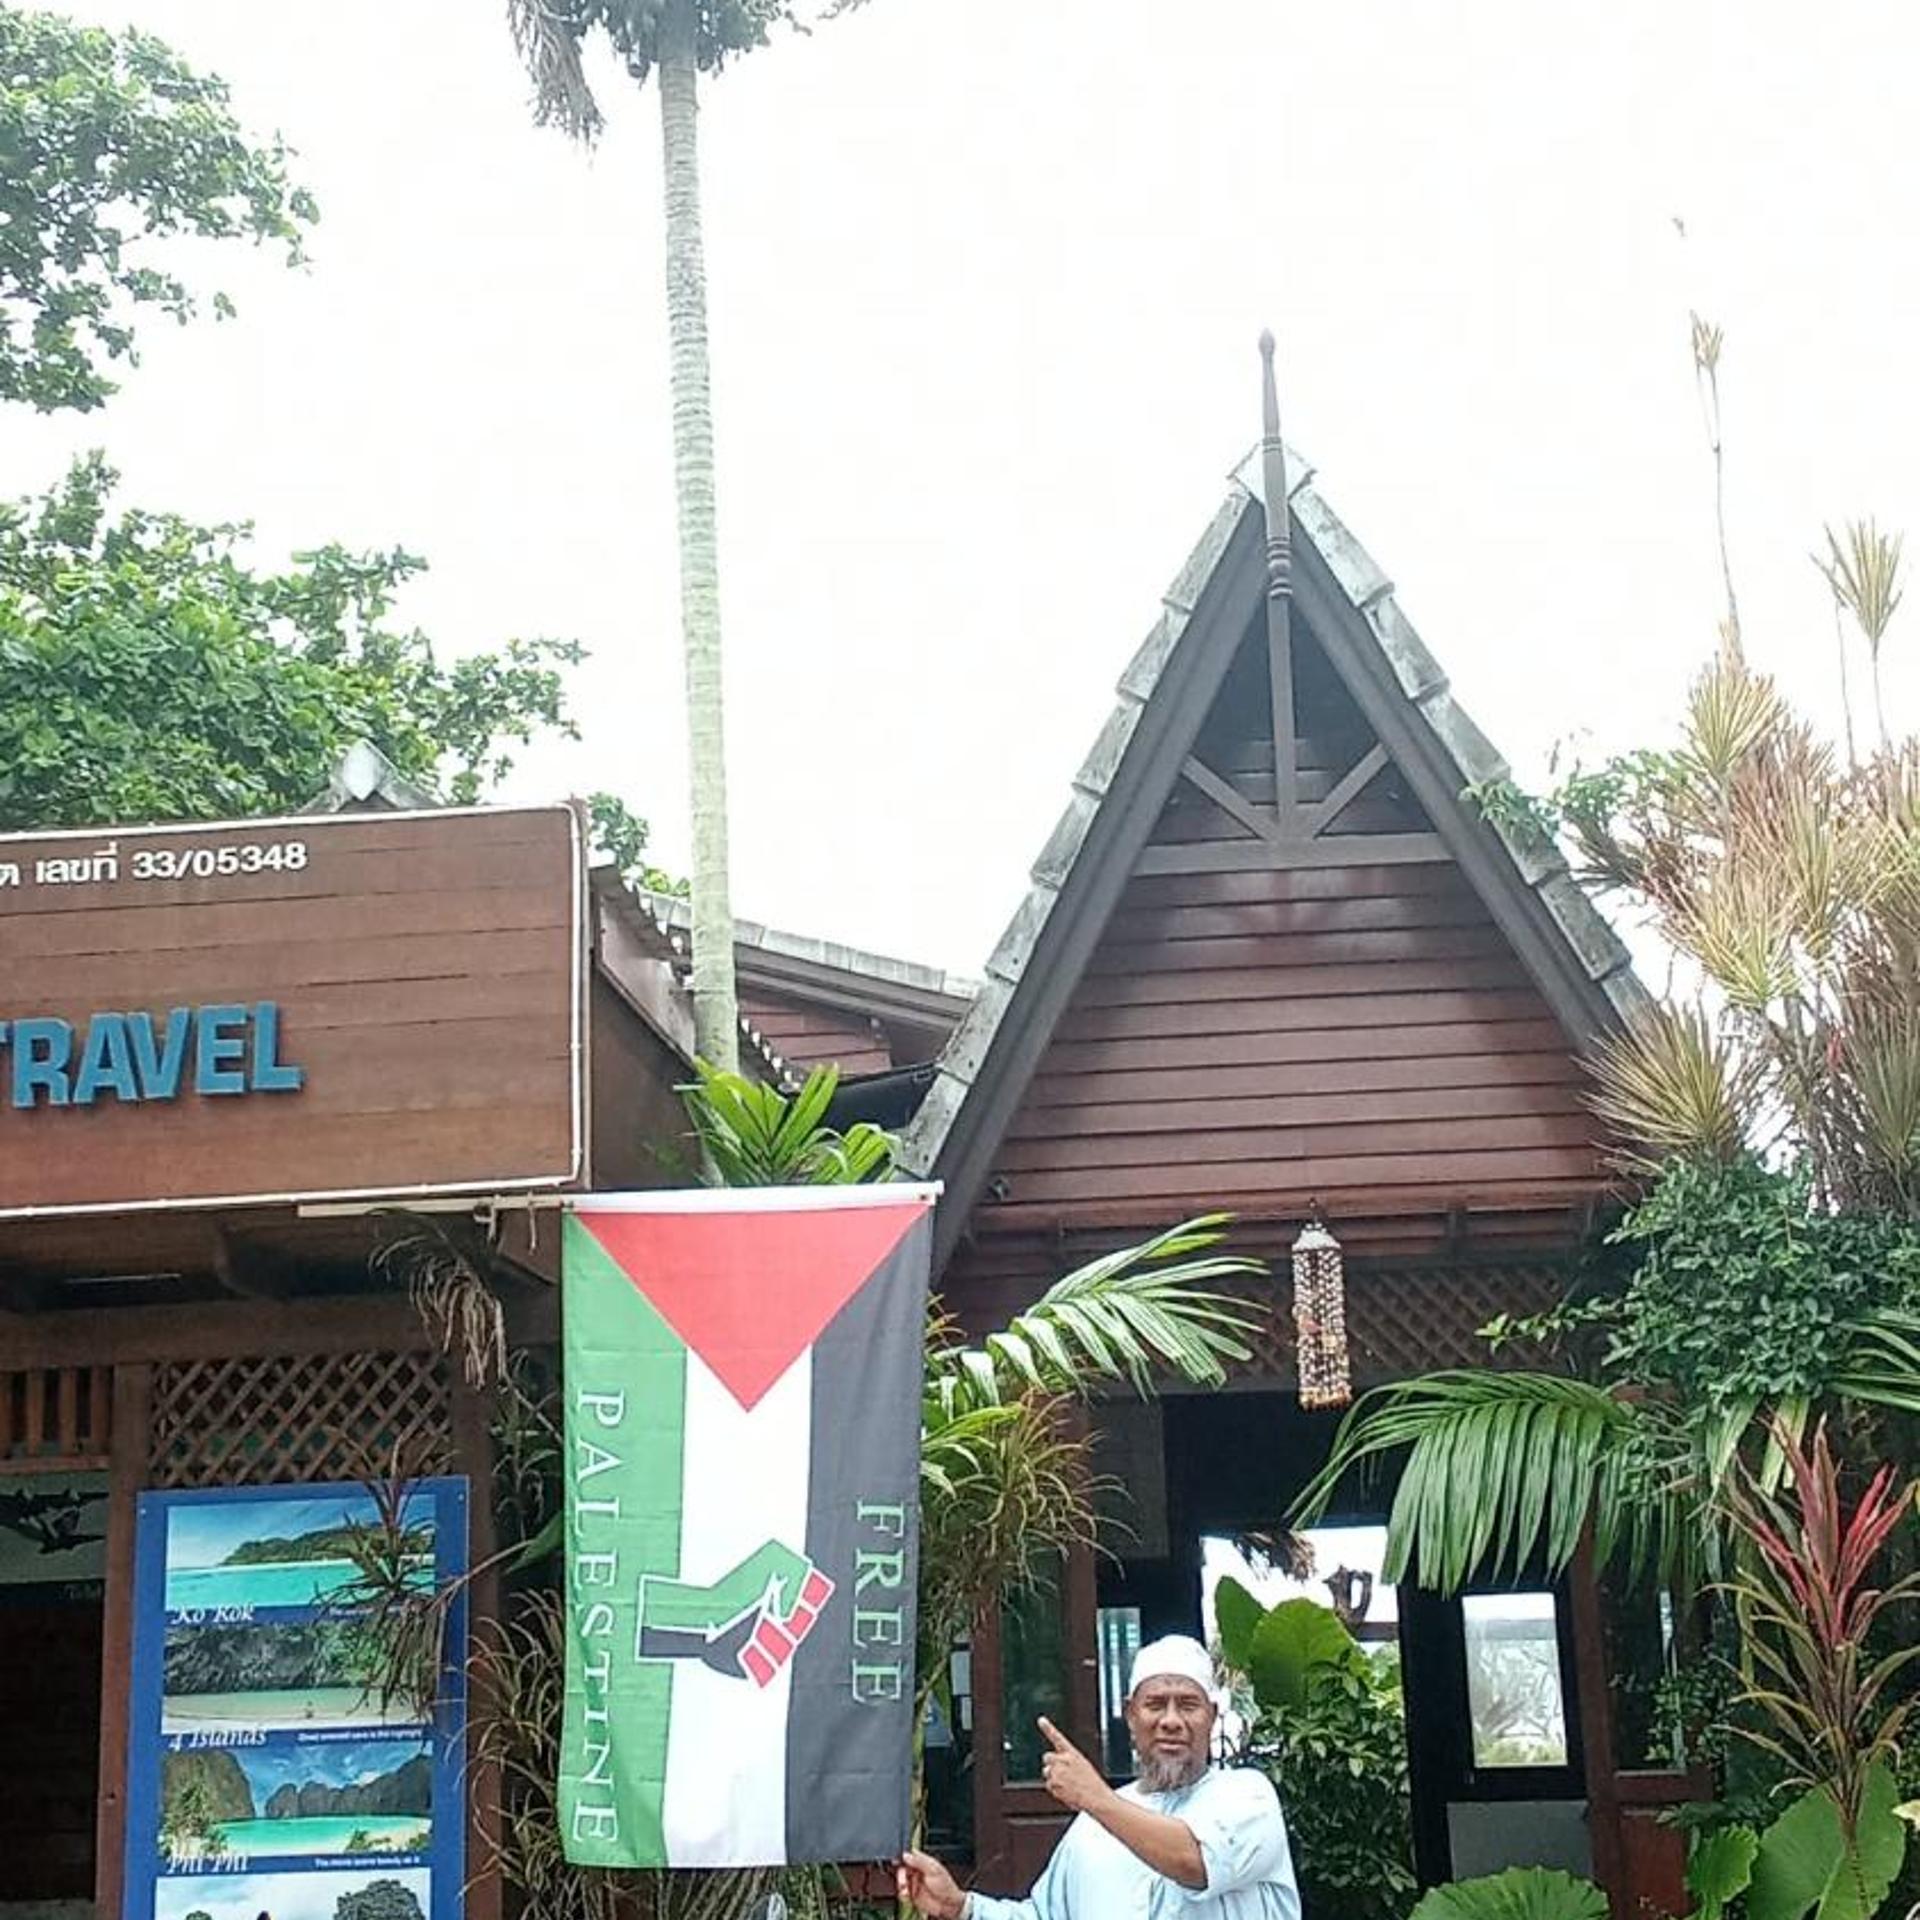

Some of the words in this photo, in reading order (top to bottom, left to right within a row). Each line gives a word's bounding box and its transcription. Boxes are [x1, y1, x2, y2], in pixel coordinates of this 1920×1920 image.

[36, 841, 118, 884] เลขที่
[132, 842, 308, 880] 33/05348
[0, 1000, 303, 1108] RAVEL
[572, 1388, 625, 1844] PALESTINE
[851, 1499, 904, 1704] FREE
